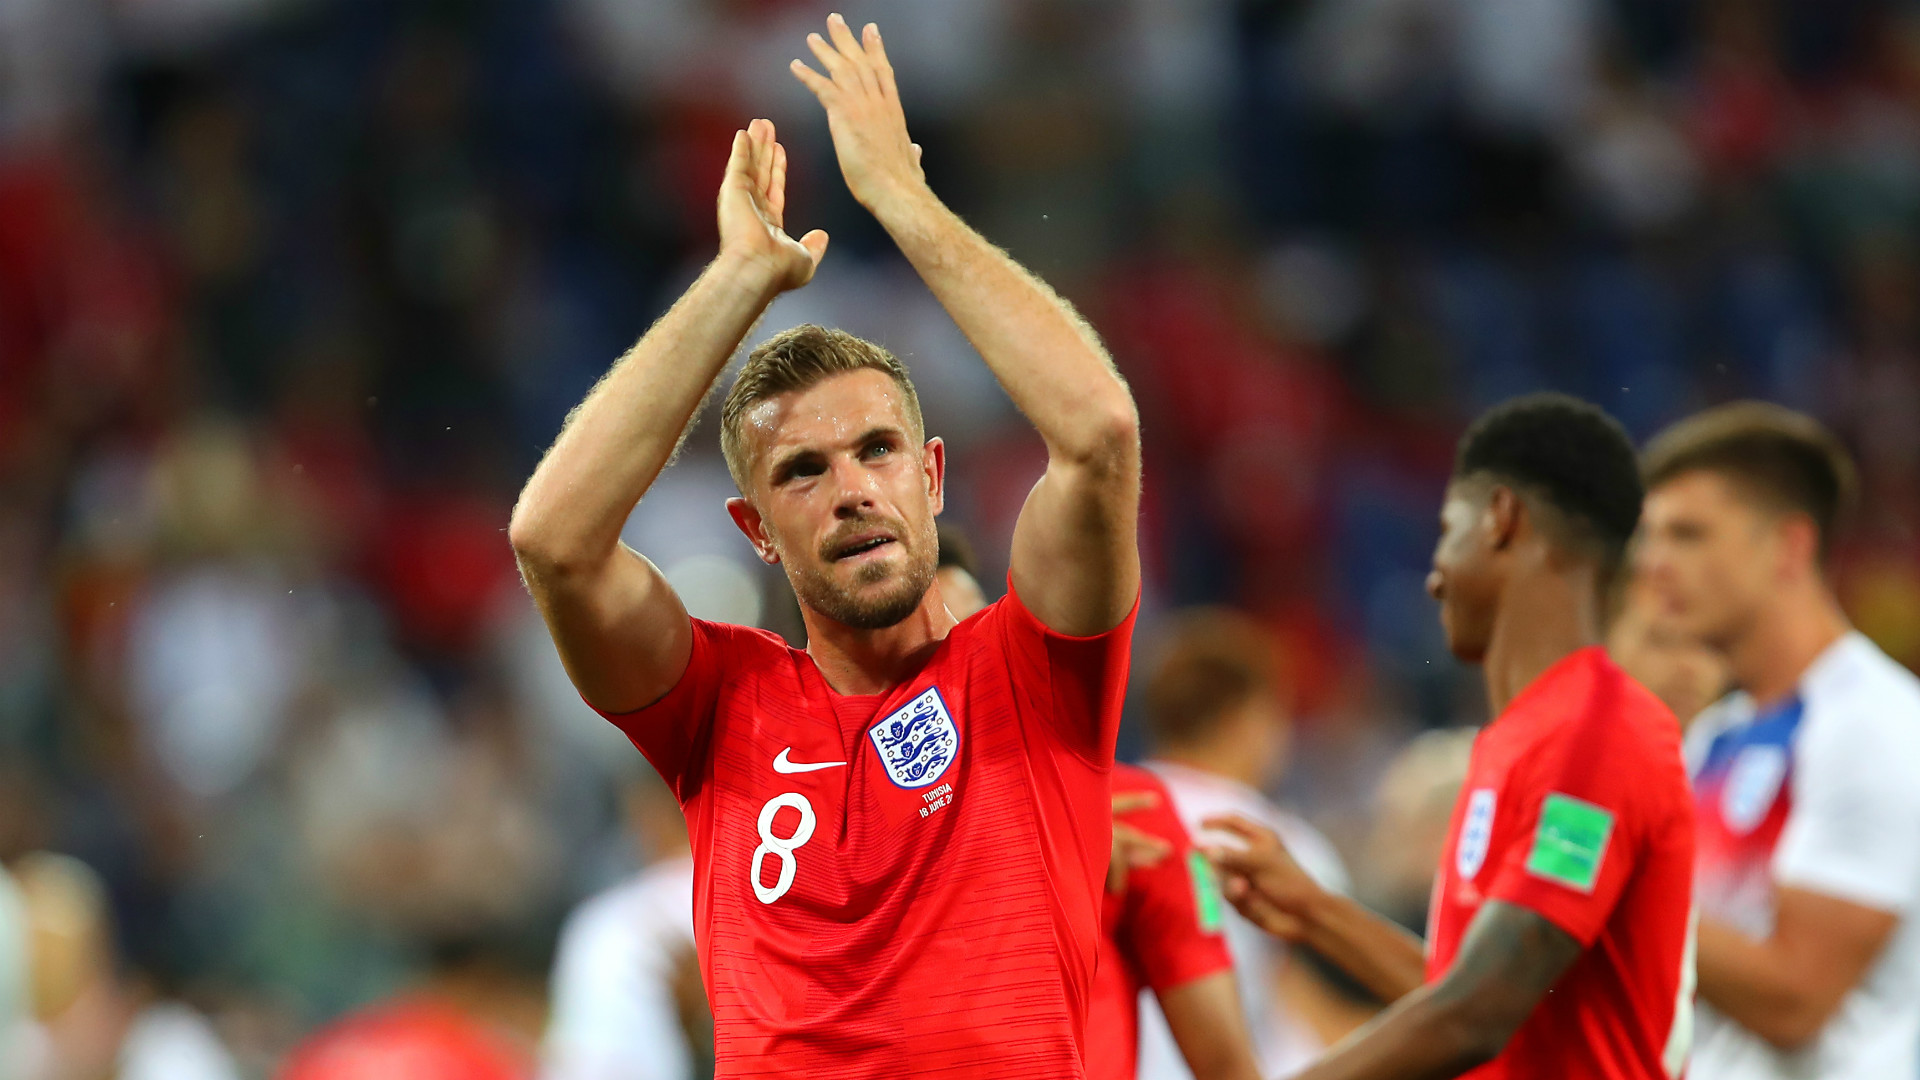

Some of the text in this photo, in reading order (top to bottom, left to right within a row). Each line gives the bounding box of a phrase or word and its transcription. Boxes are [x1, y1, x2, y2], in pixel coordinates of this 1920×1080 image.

[921, 783, 953, 803] TUNISIA
[919, 807, 929, 818] 18
[928, 796, 946, 814] JUNE
[750, 792, 817, 904] 8
